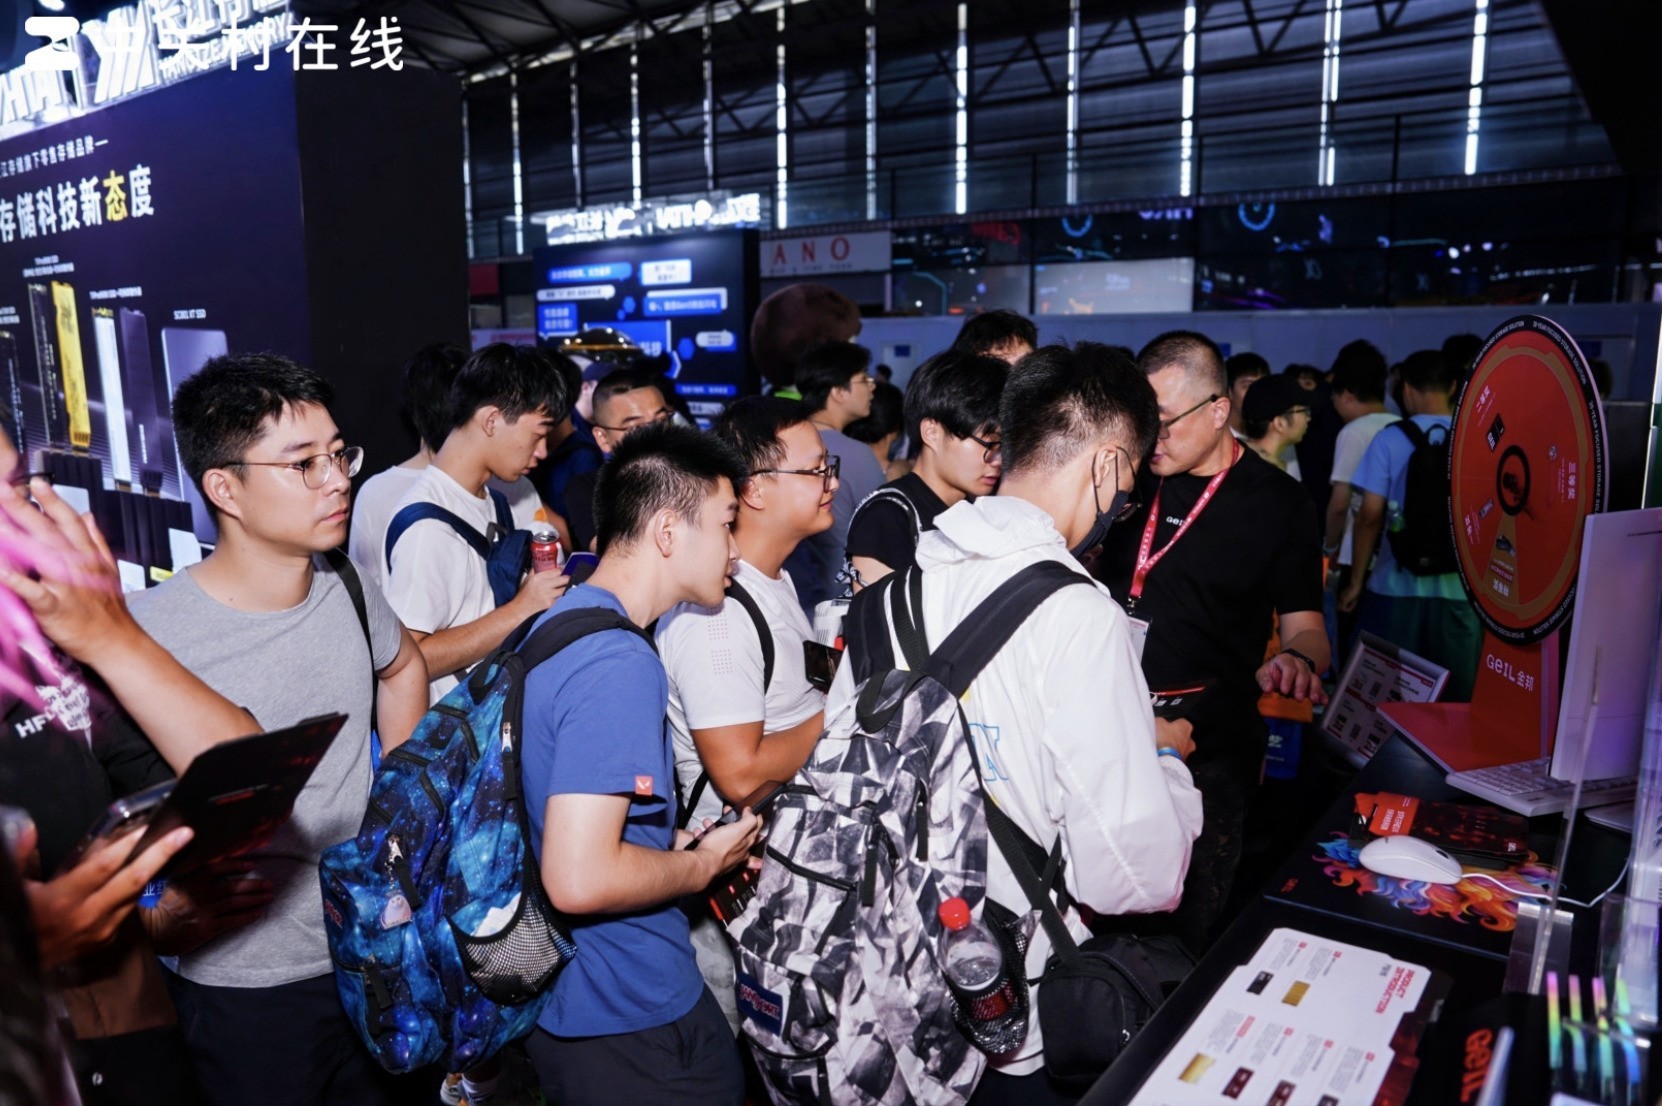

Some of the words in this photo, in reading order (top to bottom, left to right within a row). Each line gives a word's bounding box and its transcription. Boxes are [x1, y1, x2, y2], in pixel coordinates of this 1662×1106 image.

[0, 164, 154, 243] 存储科技新态度
